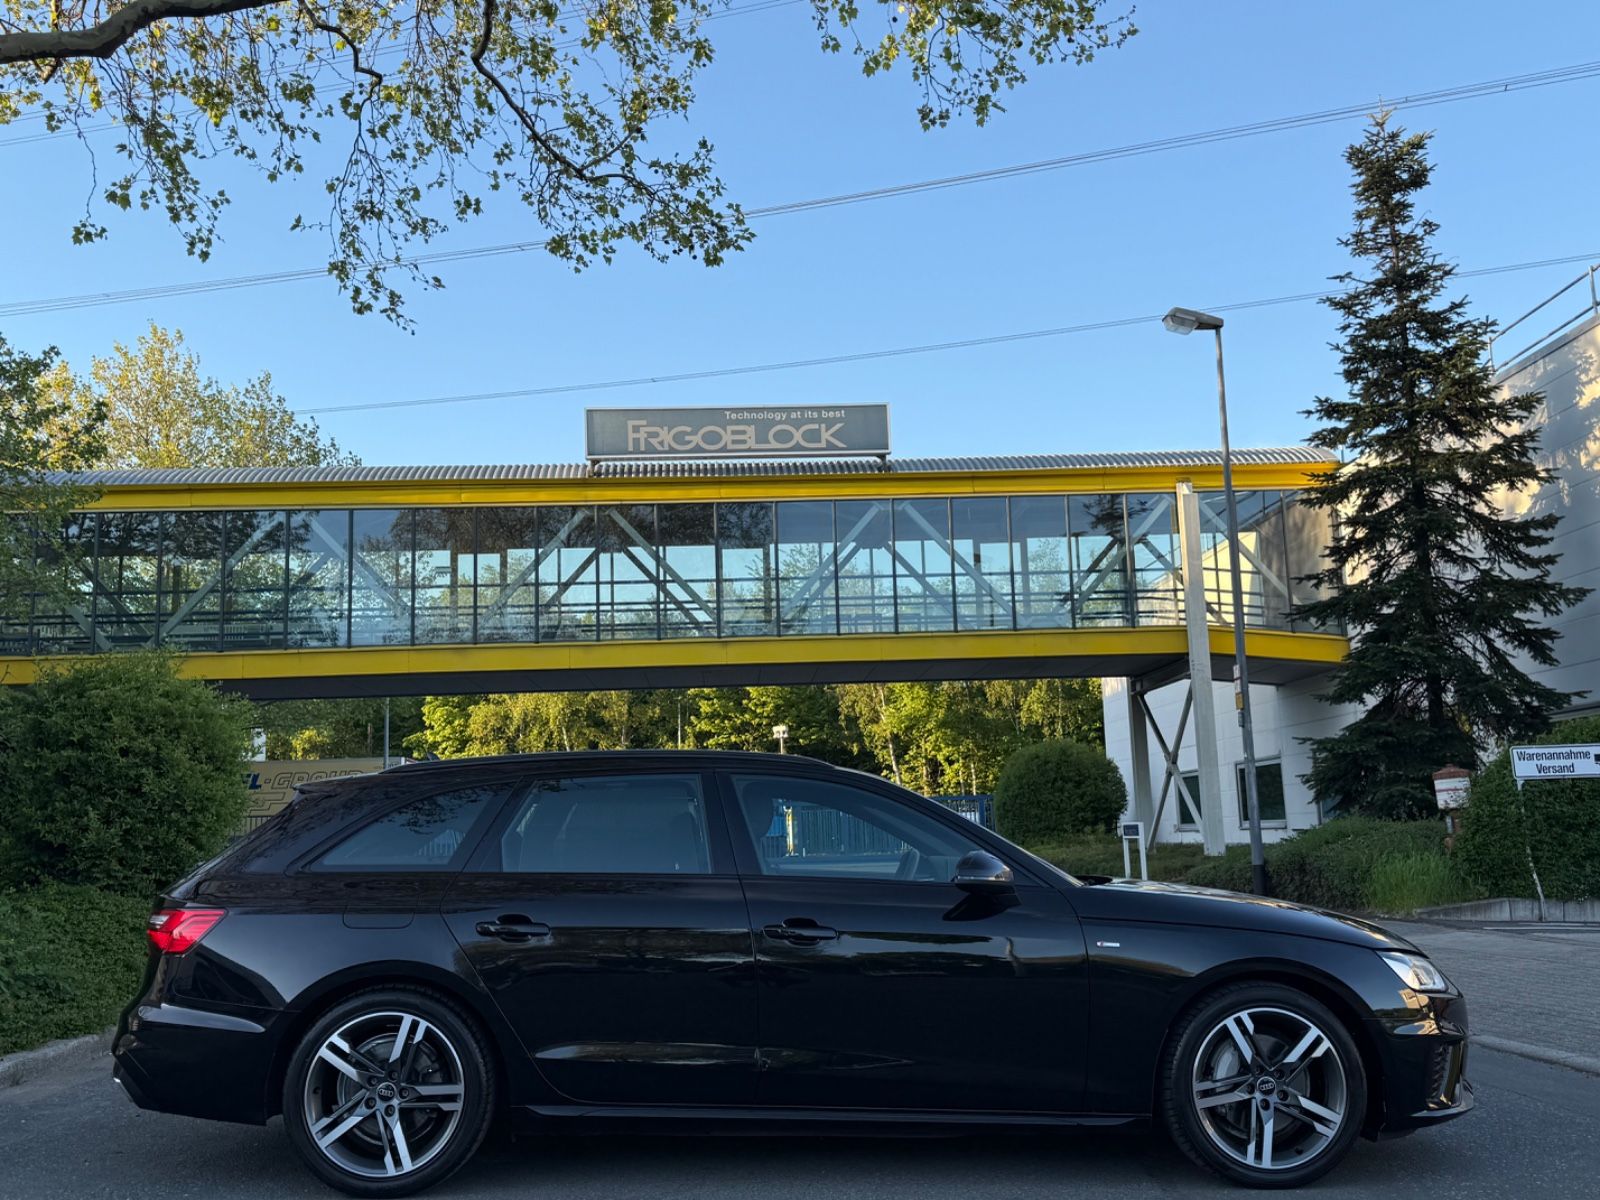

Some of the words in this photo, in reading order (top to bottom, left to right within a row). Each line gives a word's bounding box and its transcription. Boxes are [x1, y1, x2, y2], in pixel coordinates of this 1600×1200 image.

[724, 410, 787, 421] Technology
[790, 410, 802, 419] at
[805, 409, 818, 419] its
[821, 409, 846, 418] best
[627, 419, 847, 451] FRIGOBLOCK
[1516, 749, 1591, 761] Warenannahme
[1536, 762, 1575, 774] Versand
